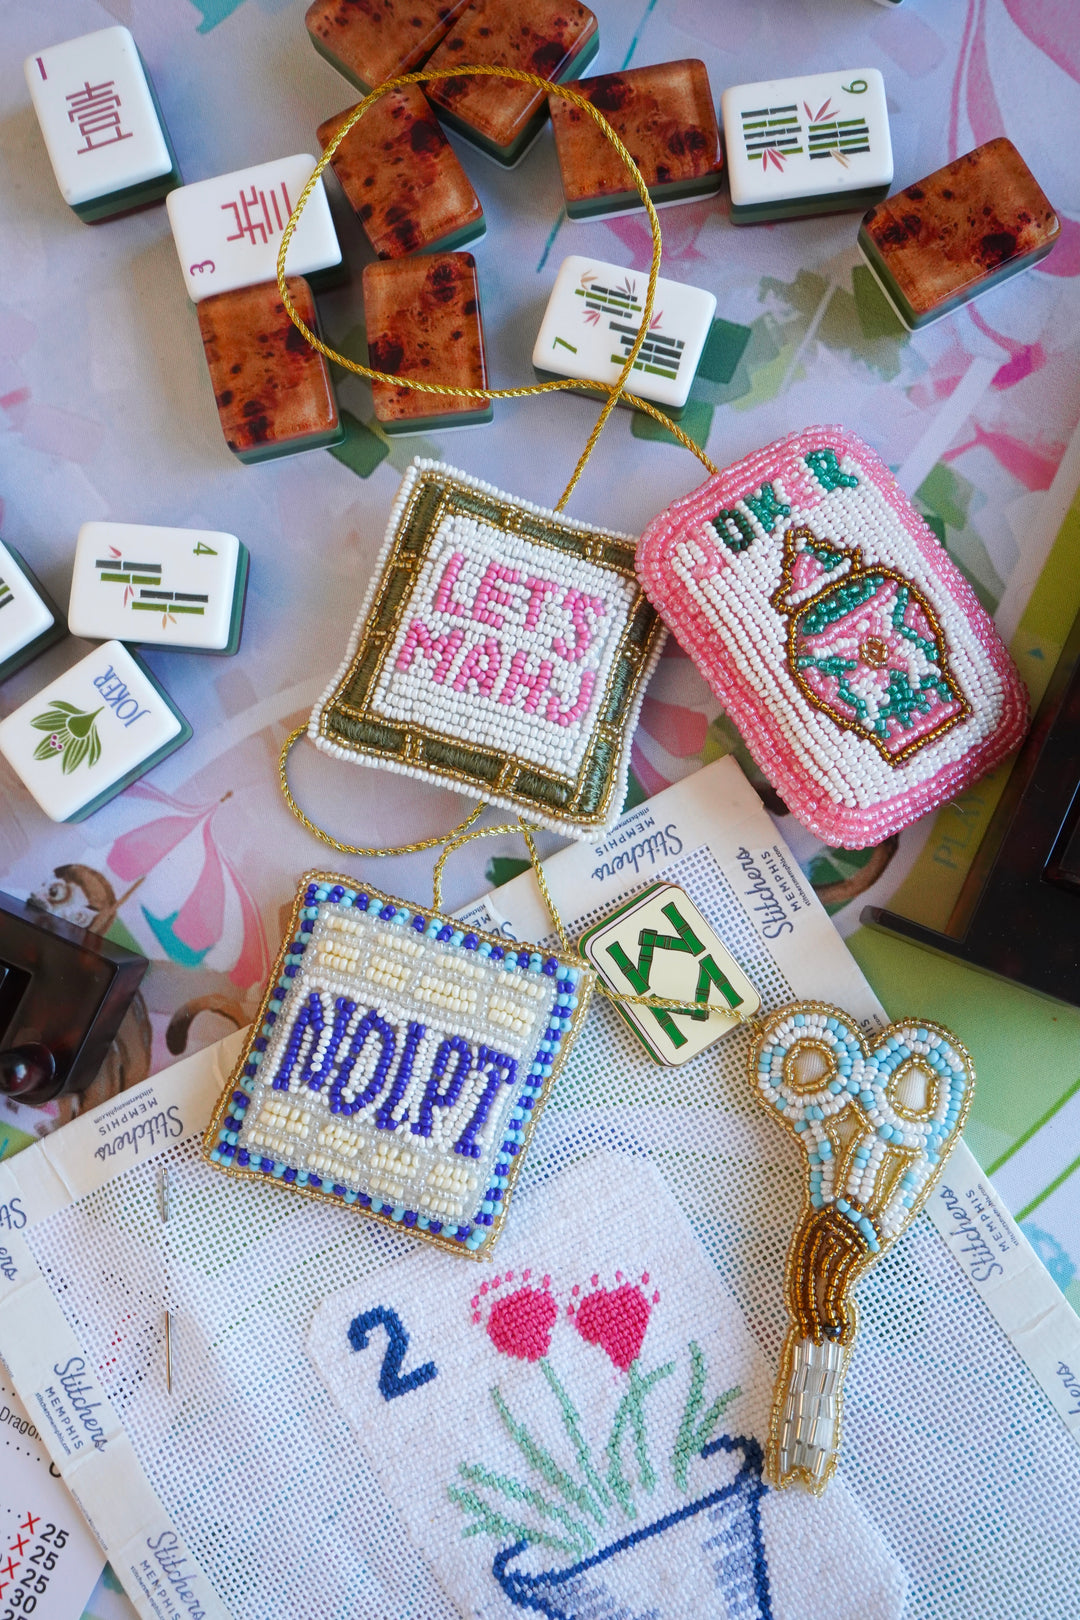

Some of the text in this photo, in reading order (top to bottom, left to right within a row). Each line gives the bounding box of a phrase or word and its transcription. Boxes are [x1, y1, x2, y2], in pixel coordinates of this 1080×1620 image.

[36, 57, 47, 80] 1
[841, 80, 868, 94] 9
[190, 260, 215, 276] 3
[553, 336, 578, 354] 7
[689, 448, 860, 579] JOKER
[193, 541, 218, 556] 4
[93, 664, 151, 728] JOKER
[396, 618, 596, 727] MAHJ
[591, 824, 683, 881] Stitchers
[595, 817, 655, 856] MEMPHIS
[736, 847, 794, 938] Stitchers
[761, 851, 801, 912] MEMPHIS
[773, 845, 811, 906] stitchersmemphis.com
[94, 1105, 184, 1161] Stitchers
[99, 1097, 158, 1136] MEMPHIS
[940, 1185, 1003, 1281] Stitchers
[966, 1189, 1010, 1252] MEMPHIS
[347, 1305, 438, 1402] 2
[45, 1386, 84, 1450] MEMPHIS
[54, 1357, 108, 1452] Stitchers
[29, 1545, 59, 1571] 25
[40, 1523, 70, 1549] 25
[10, 1588, 37, 1614] 30
[20, 1568, 50, 1594] 25
[147, 1531, 206, 1620] Stitchers
